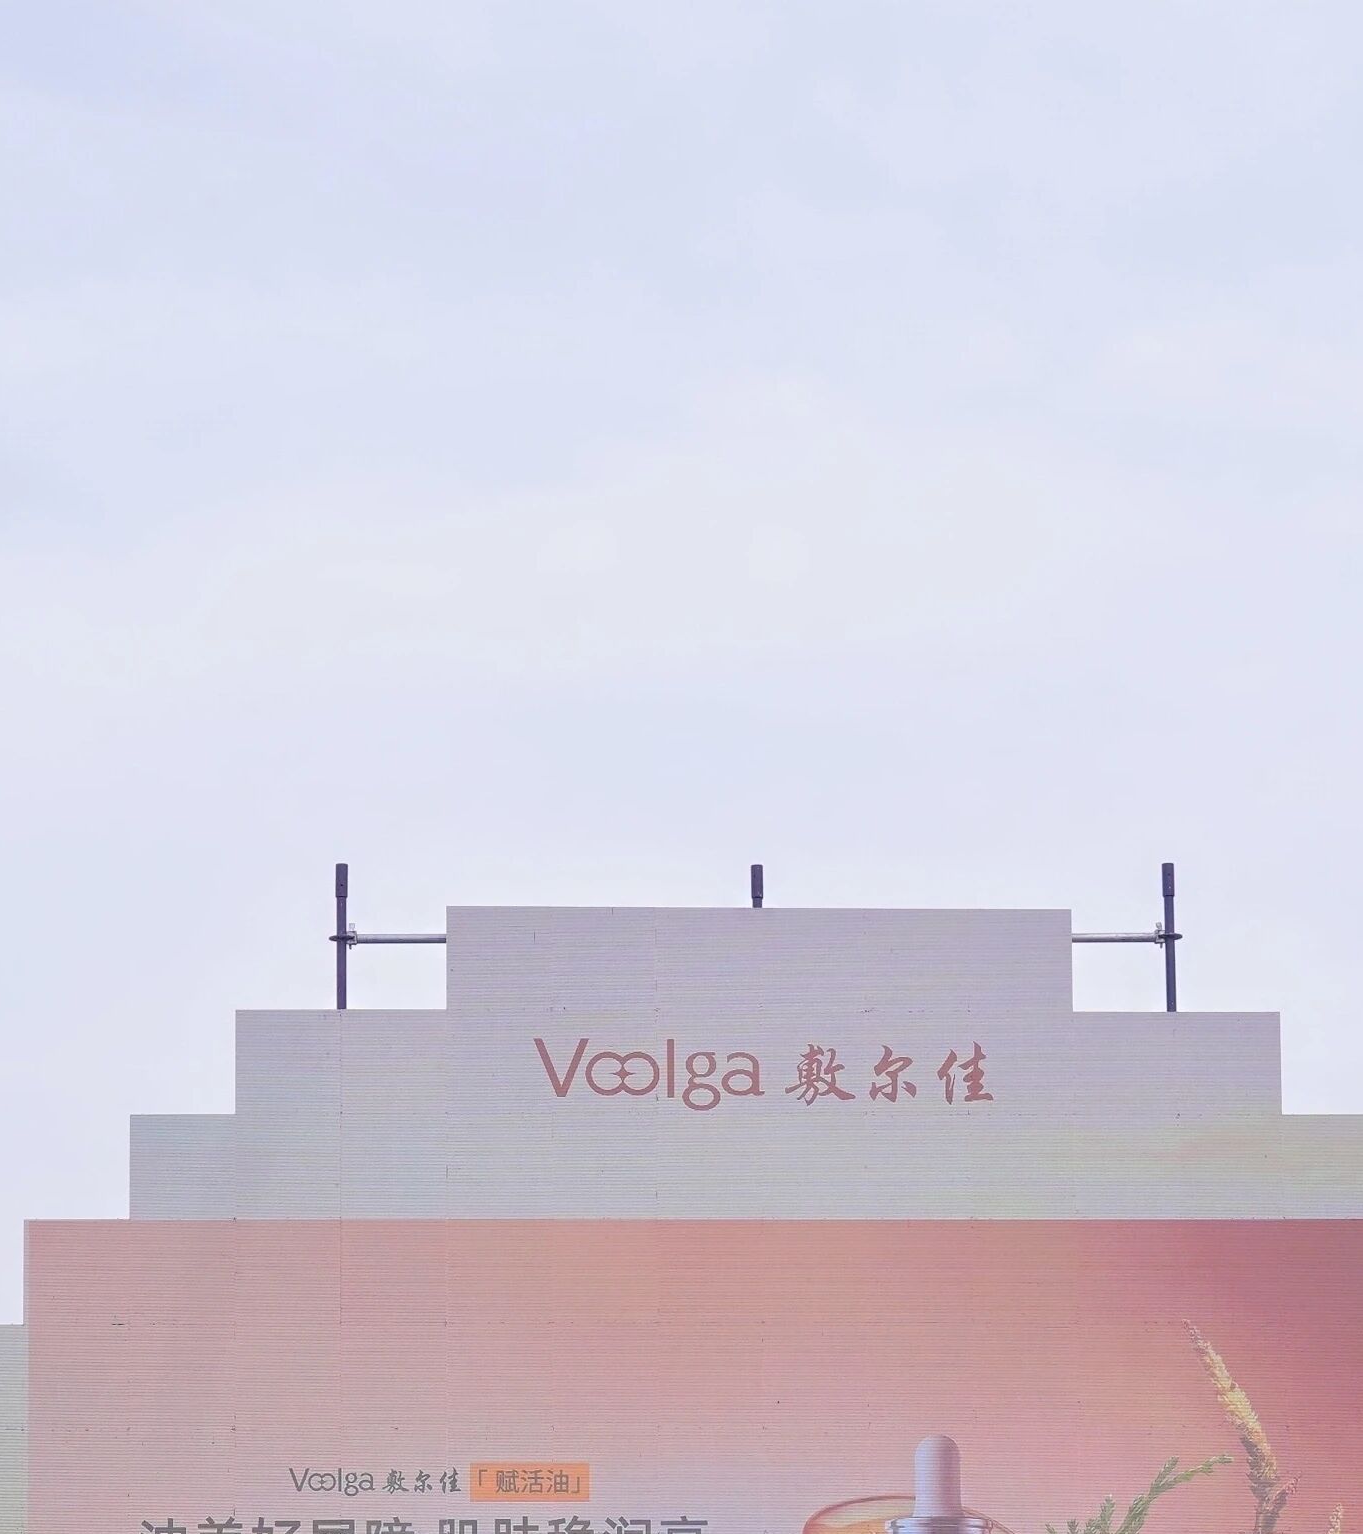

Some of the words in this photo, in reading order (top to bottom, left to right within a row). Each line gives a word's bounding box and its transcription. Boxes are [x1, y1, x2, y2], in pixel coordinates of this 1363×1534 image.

[533, 1037, 762, 1111] Voolga
[784, 1042, 997, 1108] 敷尔佳
[289, 1467, 375, 1497] Voolga
[382, 1467, 462, 1496] 敷尔佳
